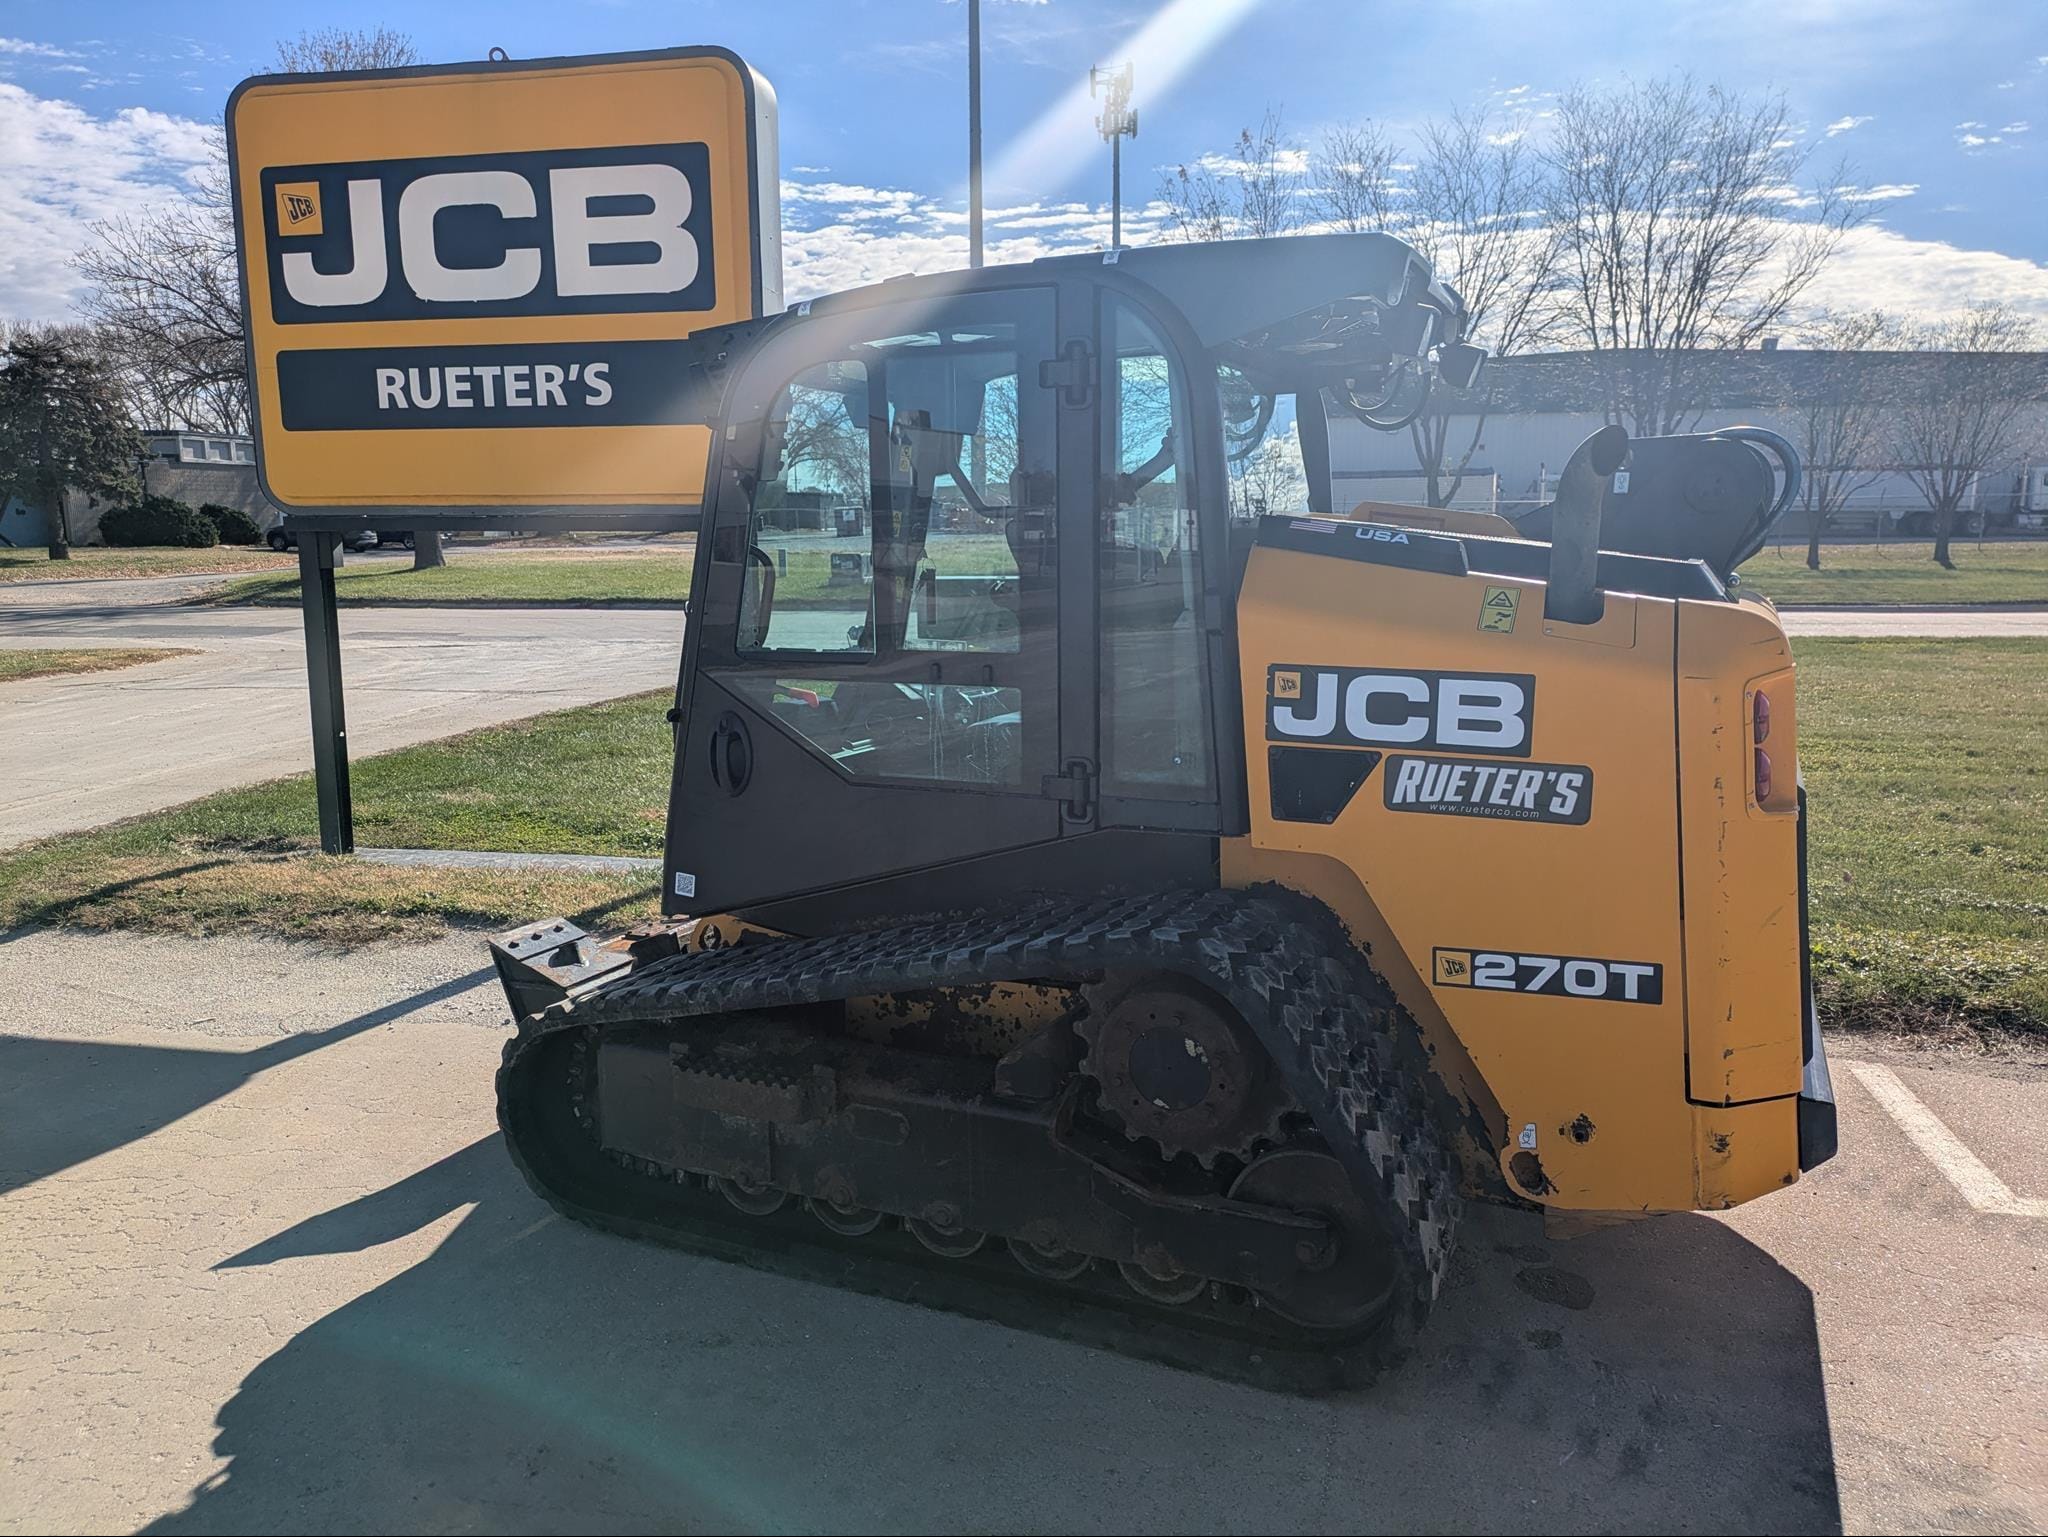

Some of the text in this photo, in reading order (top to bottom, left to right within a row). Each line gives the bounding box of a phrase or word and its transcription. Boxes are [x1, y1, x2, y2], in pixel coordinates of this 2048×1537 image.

[287, 196, 314, 221] JCB
[282, 164, 698, 307] JCB
[376, 362, 612, 409] RUETER'S
[1355, 528, 1409, 545] USA
[1280, 676, 1297, 691] JCB
[1273, 673, 1525, 748] JCB
[1392, 759, 1584, 816] RUETER'S
[1429, 803, 1540, 819] www.rueterco.com
[1445, 958, 1466, 976] JCB
[1474, 953, 1654, 1000] 270T
